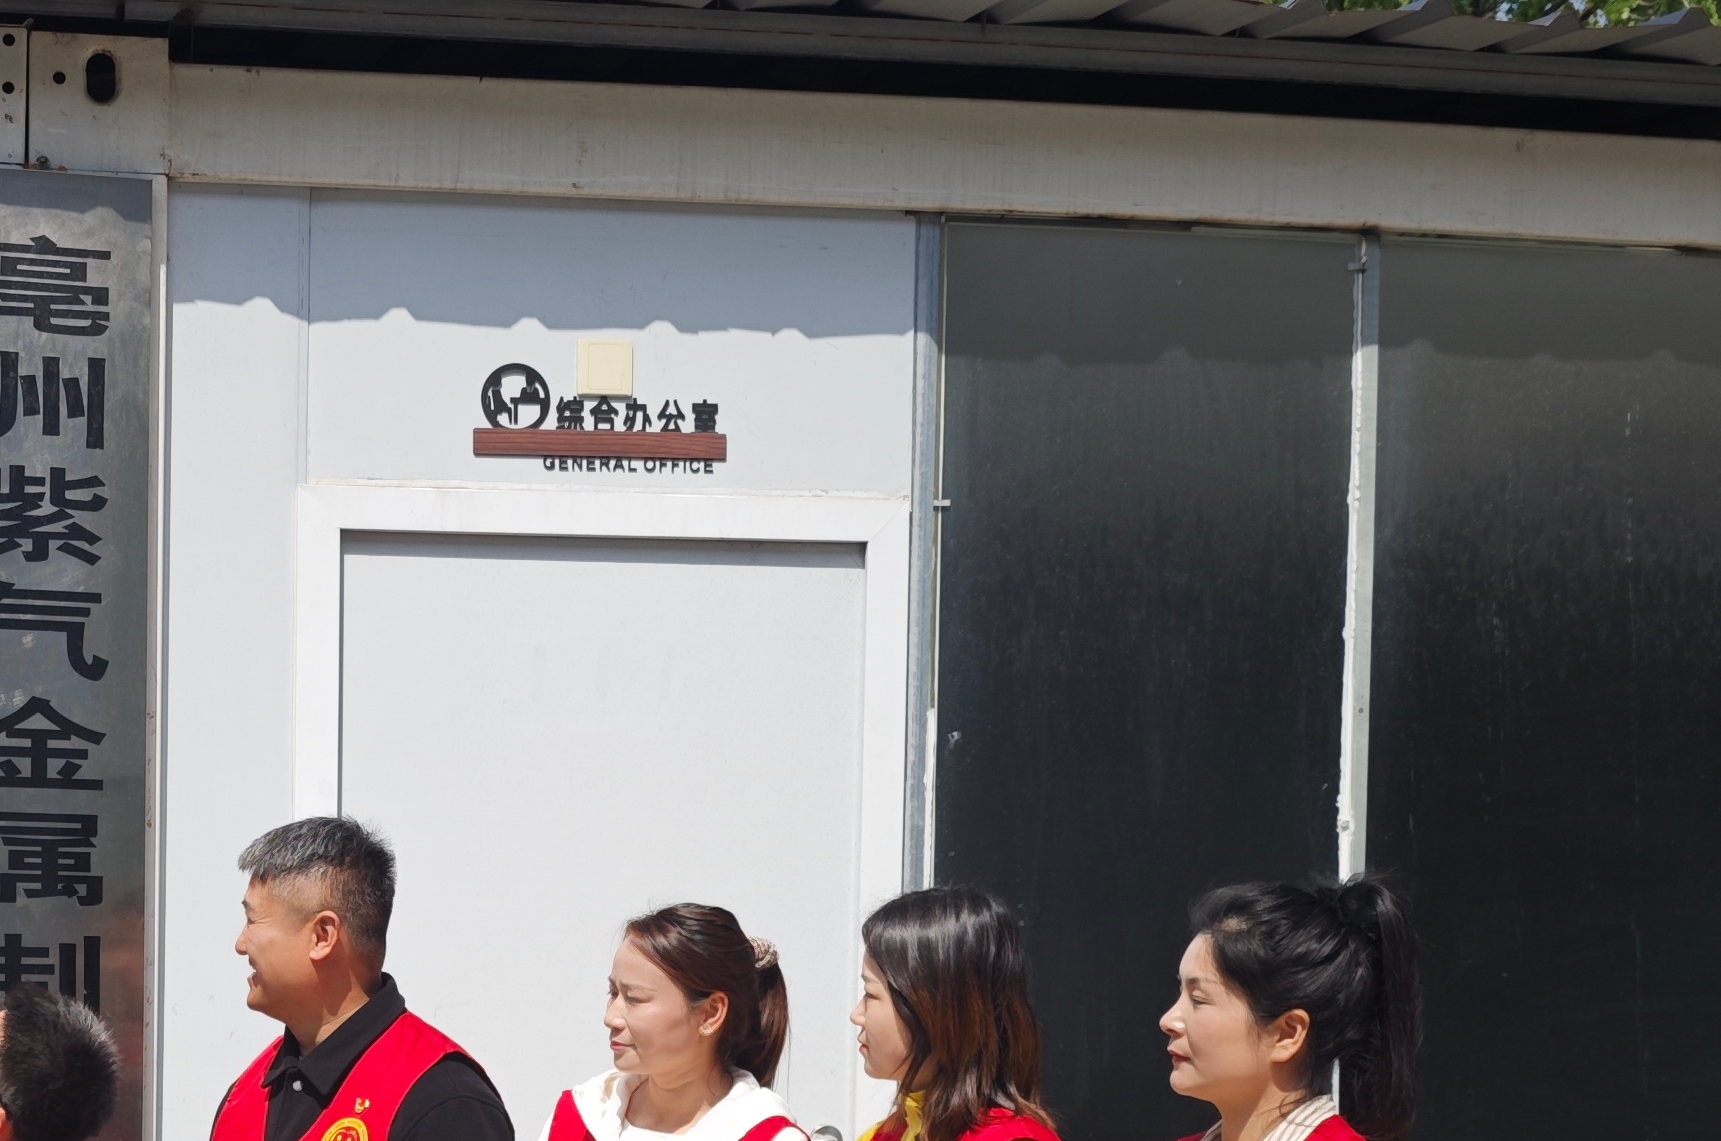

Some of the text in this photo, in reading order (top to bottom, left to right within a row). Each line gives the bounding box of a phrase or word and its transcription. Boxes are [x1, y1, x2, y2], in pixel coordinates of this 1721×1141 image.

[555, 396, 719, 433] 综合办公室
[543, 457, 714, 474] GENERAL OFFICE
